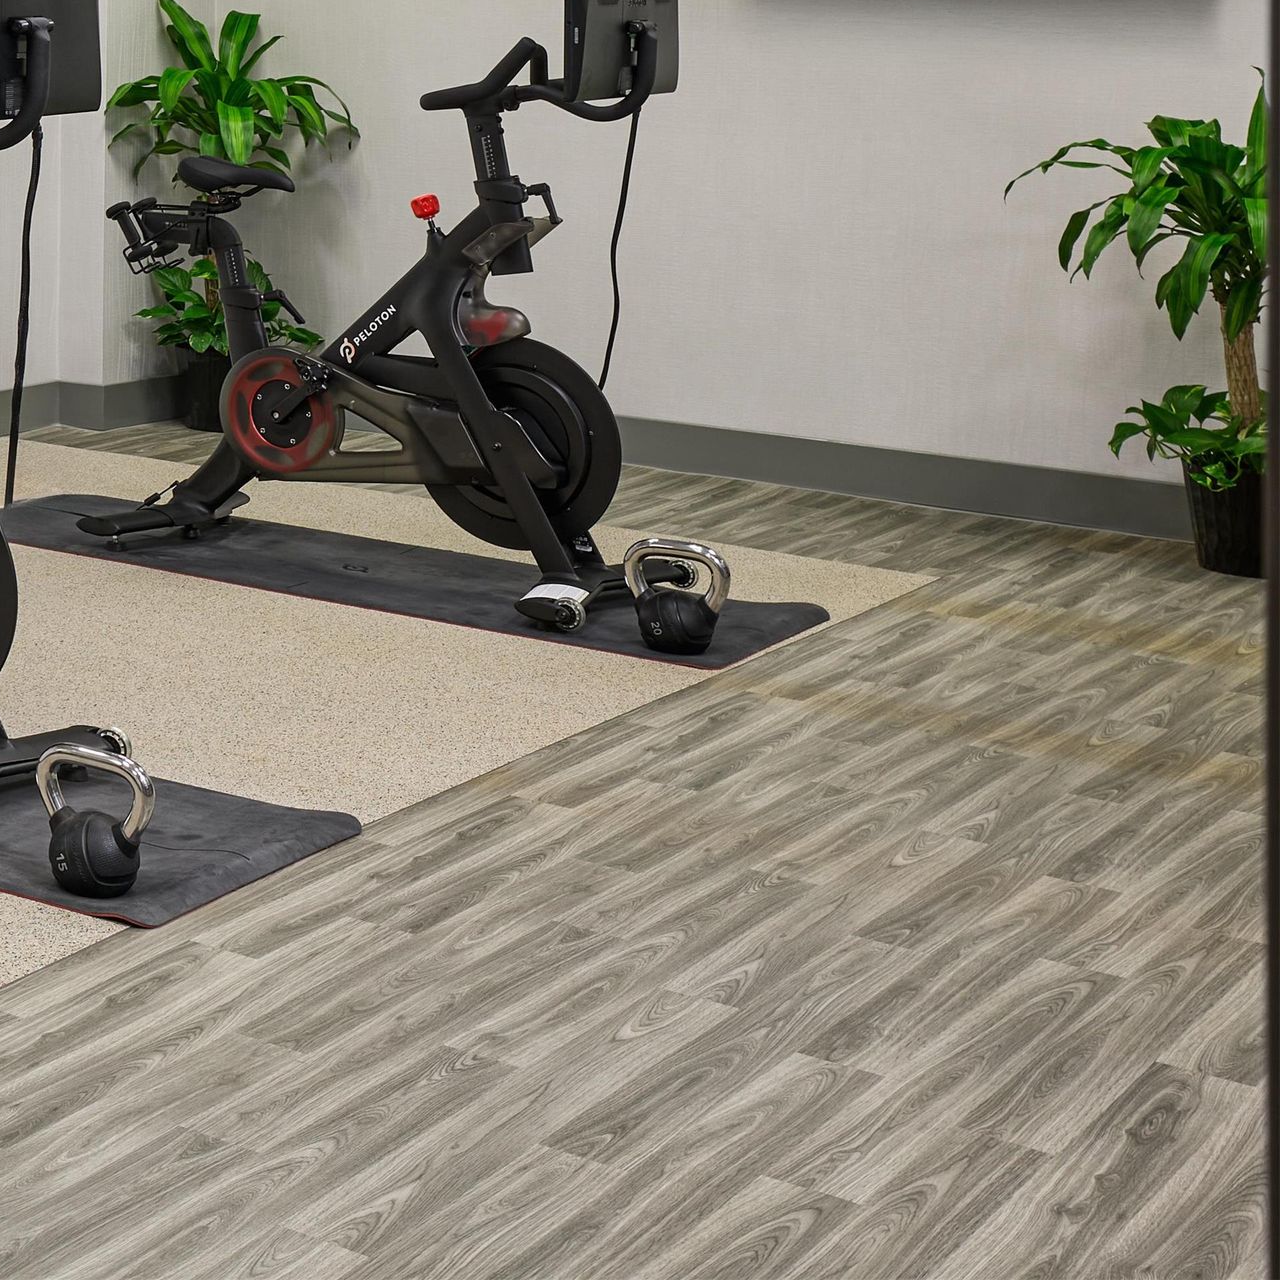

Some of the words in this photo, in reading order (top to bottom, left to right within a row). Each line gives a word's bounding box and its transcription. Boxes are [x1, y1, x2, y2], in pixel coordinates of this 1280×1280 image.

[353, 304, 396, 346] PELOTON
[651, 622, 662, 635] 20
[56, 853, 67, 871] 15
